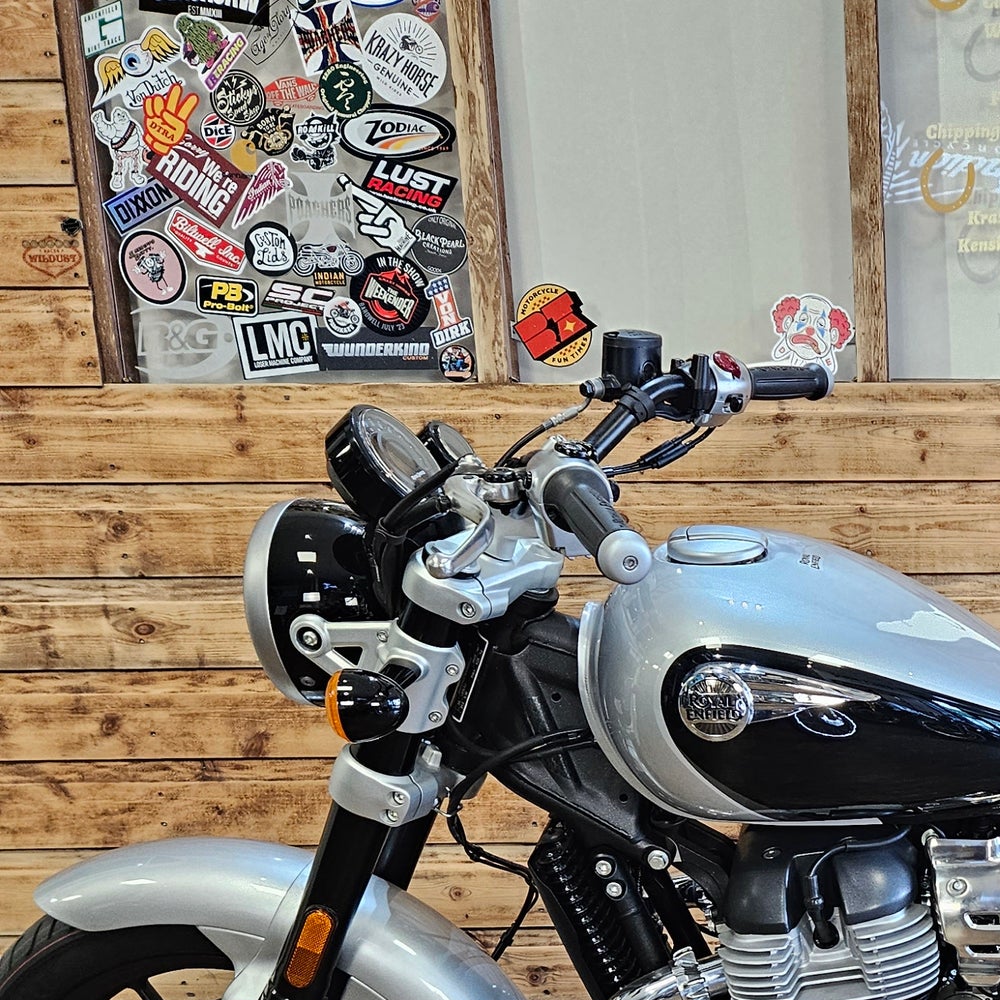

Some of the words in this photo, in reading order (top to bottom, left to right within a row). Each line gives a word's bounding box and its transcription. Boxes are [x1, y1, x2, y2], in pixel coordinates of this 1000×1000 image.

[365, 30, 404, 67] KRAZY
[400, 59, 439, 98] HORSE
[274, 79, 298, 91] VANS
[373, 63, 413, 95] GENUINE
[280, 87, 298, 101] THE
[149, 121, 175, 142] DTRA
[256, 114, 276, 130] BORN
[364, 120, 427, 146] ZODIAC
[926, 122, 1000, 142] Chipping
[155, 148, 231, 218] RIDING
[202, 156, 238, 195] We're
[372, 160, 451, 195] LUST
[113, 183, 173, 225] DIXXON
[367, 177, 443, 208] RACING
[415, 229, 440, 246] BLACK
[440, 237, 465, 249] PEARL
[422, 241, 453, 255] CREATIONS
[314, 271, 345, 281] INDIAN
[376, 256, 388, 268] IN
[387, 256, 405, 269] THE
[403, 262, 426, 288] SHOW
[211, 281, 243, 303] PB
[364, 276, 415, 320] WEEKENDER
[521, 287, 559, 316] MOTORCYCLE
[203, 300, 249, 312] Pro-Bolt
[246, 320, 311, 361] LMC
[434, 320, 472, 347] DIRK
[570, 336, 588, 359] TIMES
[290, 356, 313, 365] COMPANY
[689, 693, 737, 711] ROYAL
[686, 708, 743, 722] ENFIELD
